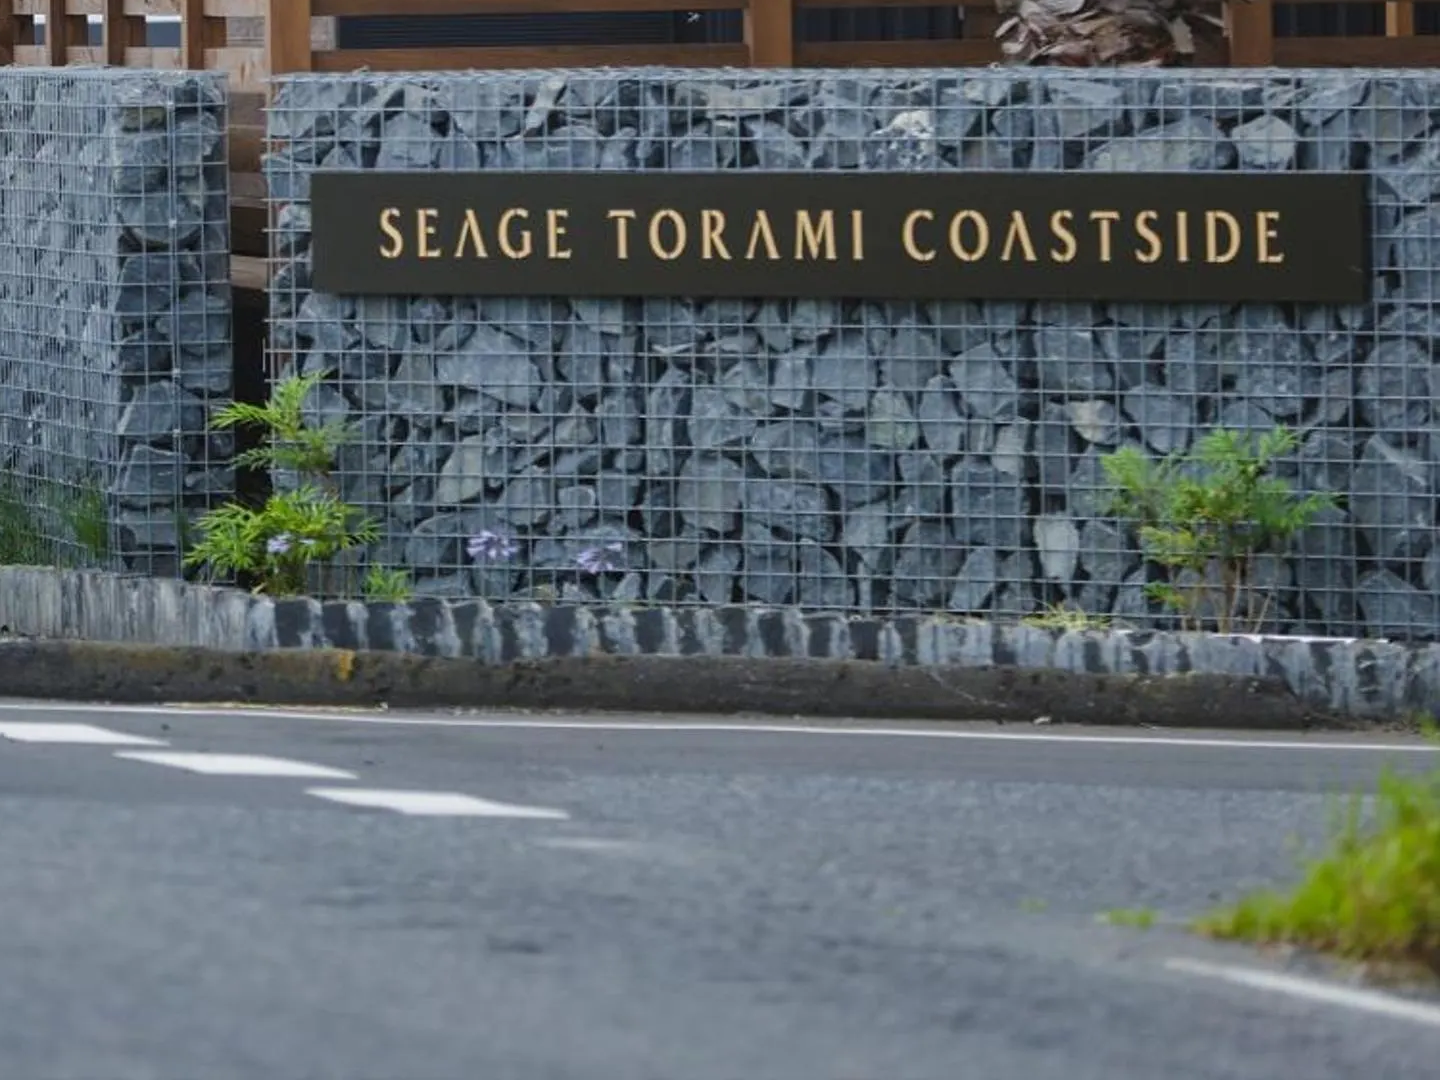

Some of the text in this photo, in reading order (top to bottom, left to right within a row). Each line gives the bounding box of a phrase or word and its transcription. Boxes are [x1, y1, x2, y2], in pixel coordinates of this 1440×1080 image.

[379, 207, 1282, 264] SEAGE TORAMI COASTSIDE
